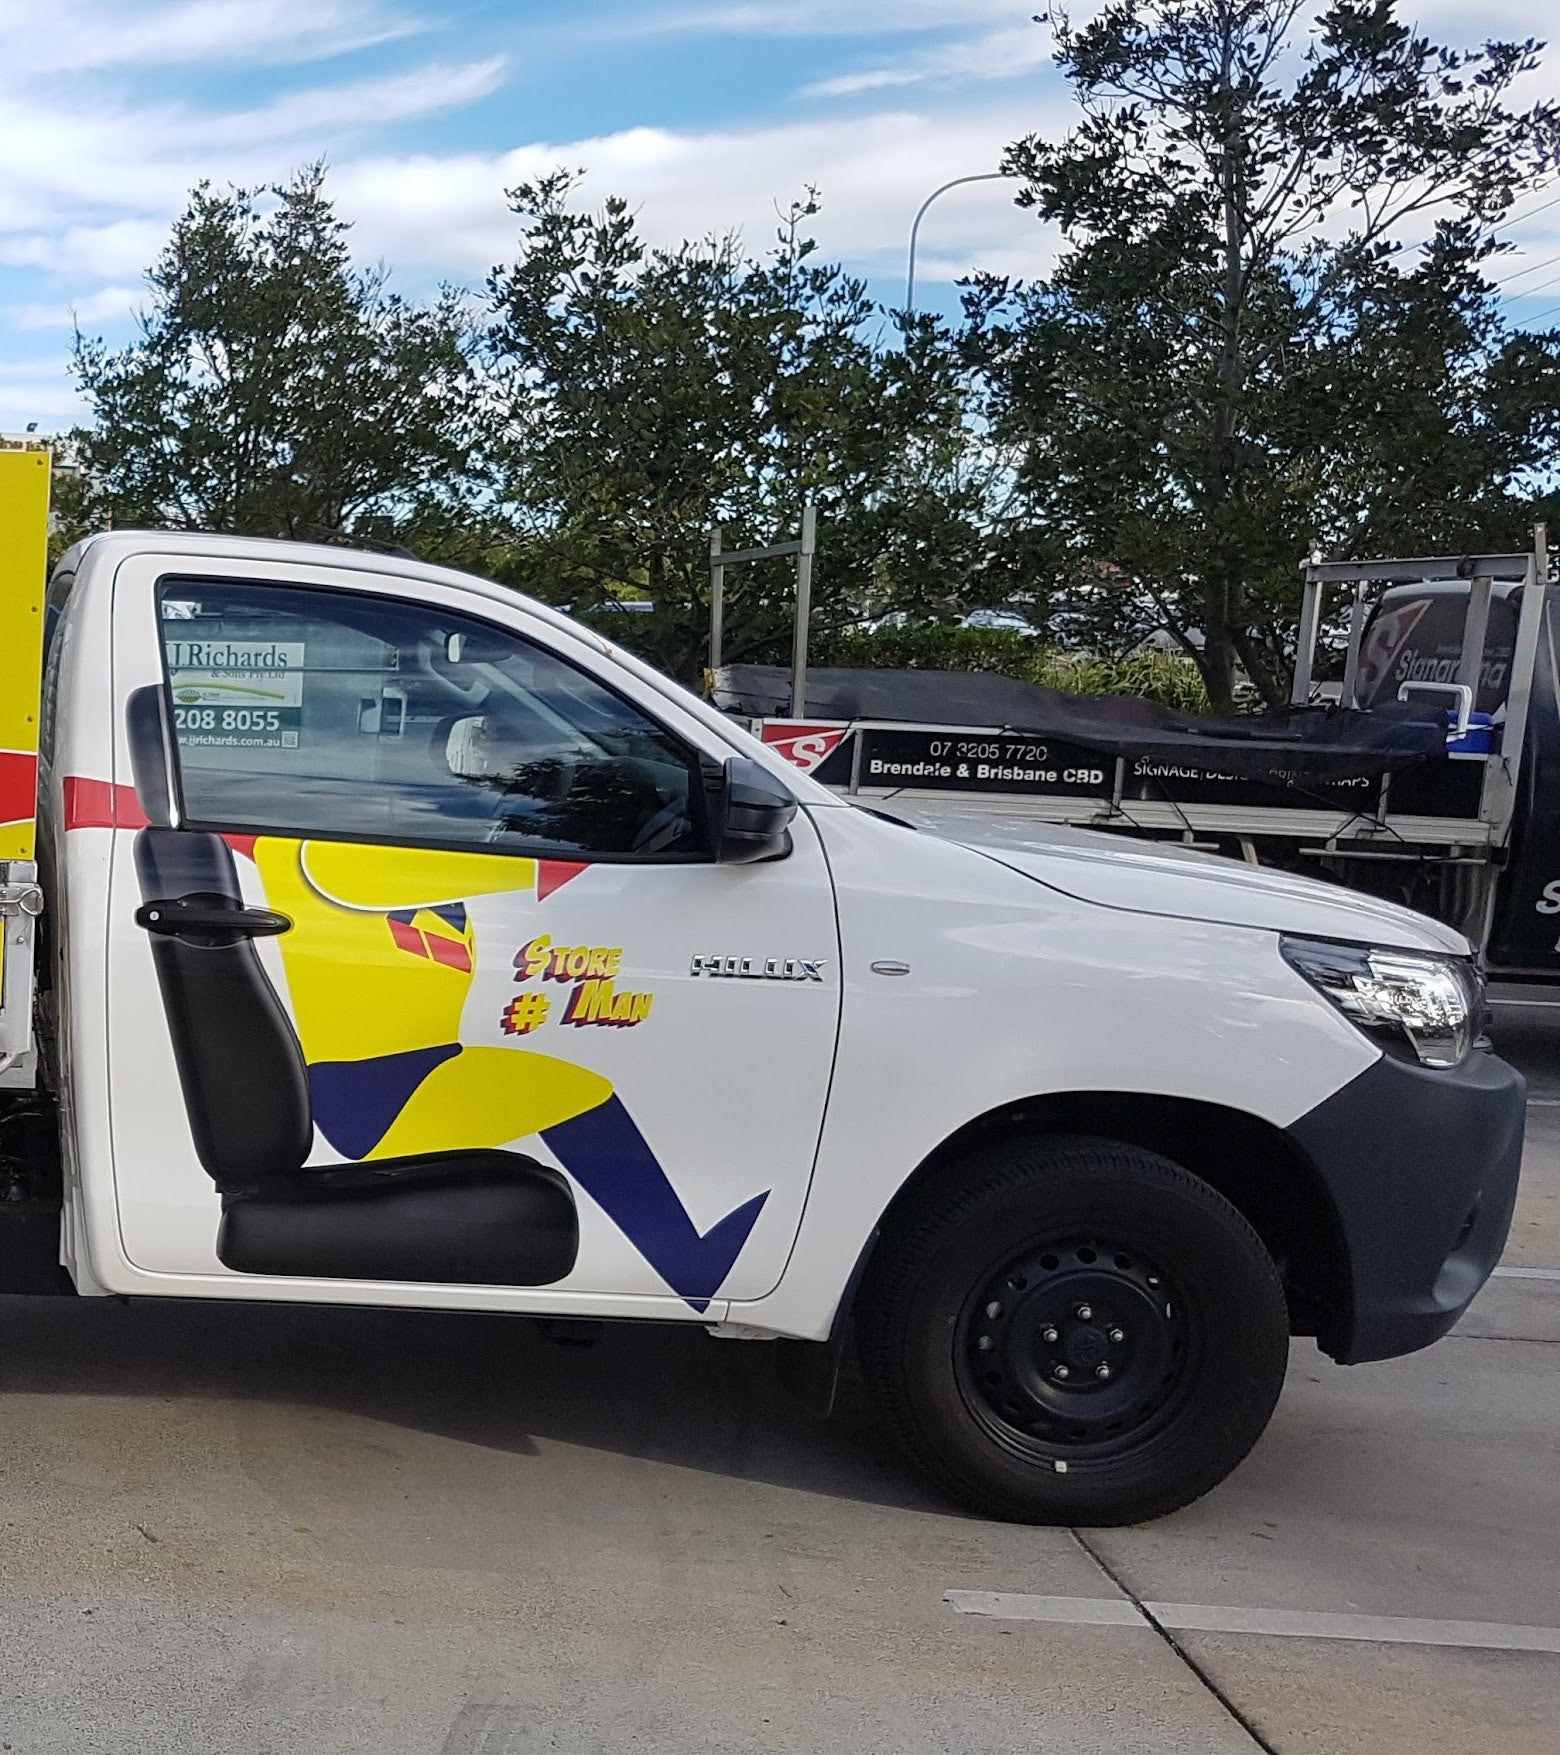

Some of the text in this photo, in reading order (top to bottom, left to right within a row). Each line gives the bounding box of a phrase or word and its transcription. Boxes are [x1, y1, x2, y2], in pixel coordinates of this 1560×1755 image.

[222, 710, 280, 731] 8055
[930, 741, 1048, 761] 07 3205 7720
[870, 759, 1104, 784] Brendale & Brisbane CBD
[690, 954, 828, 983] HILUX
